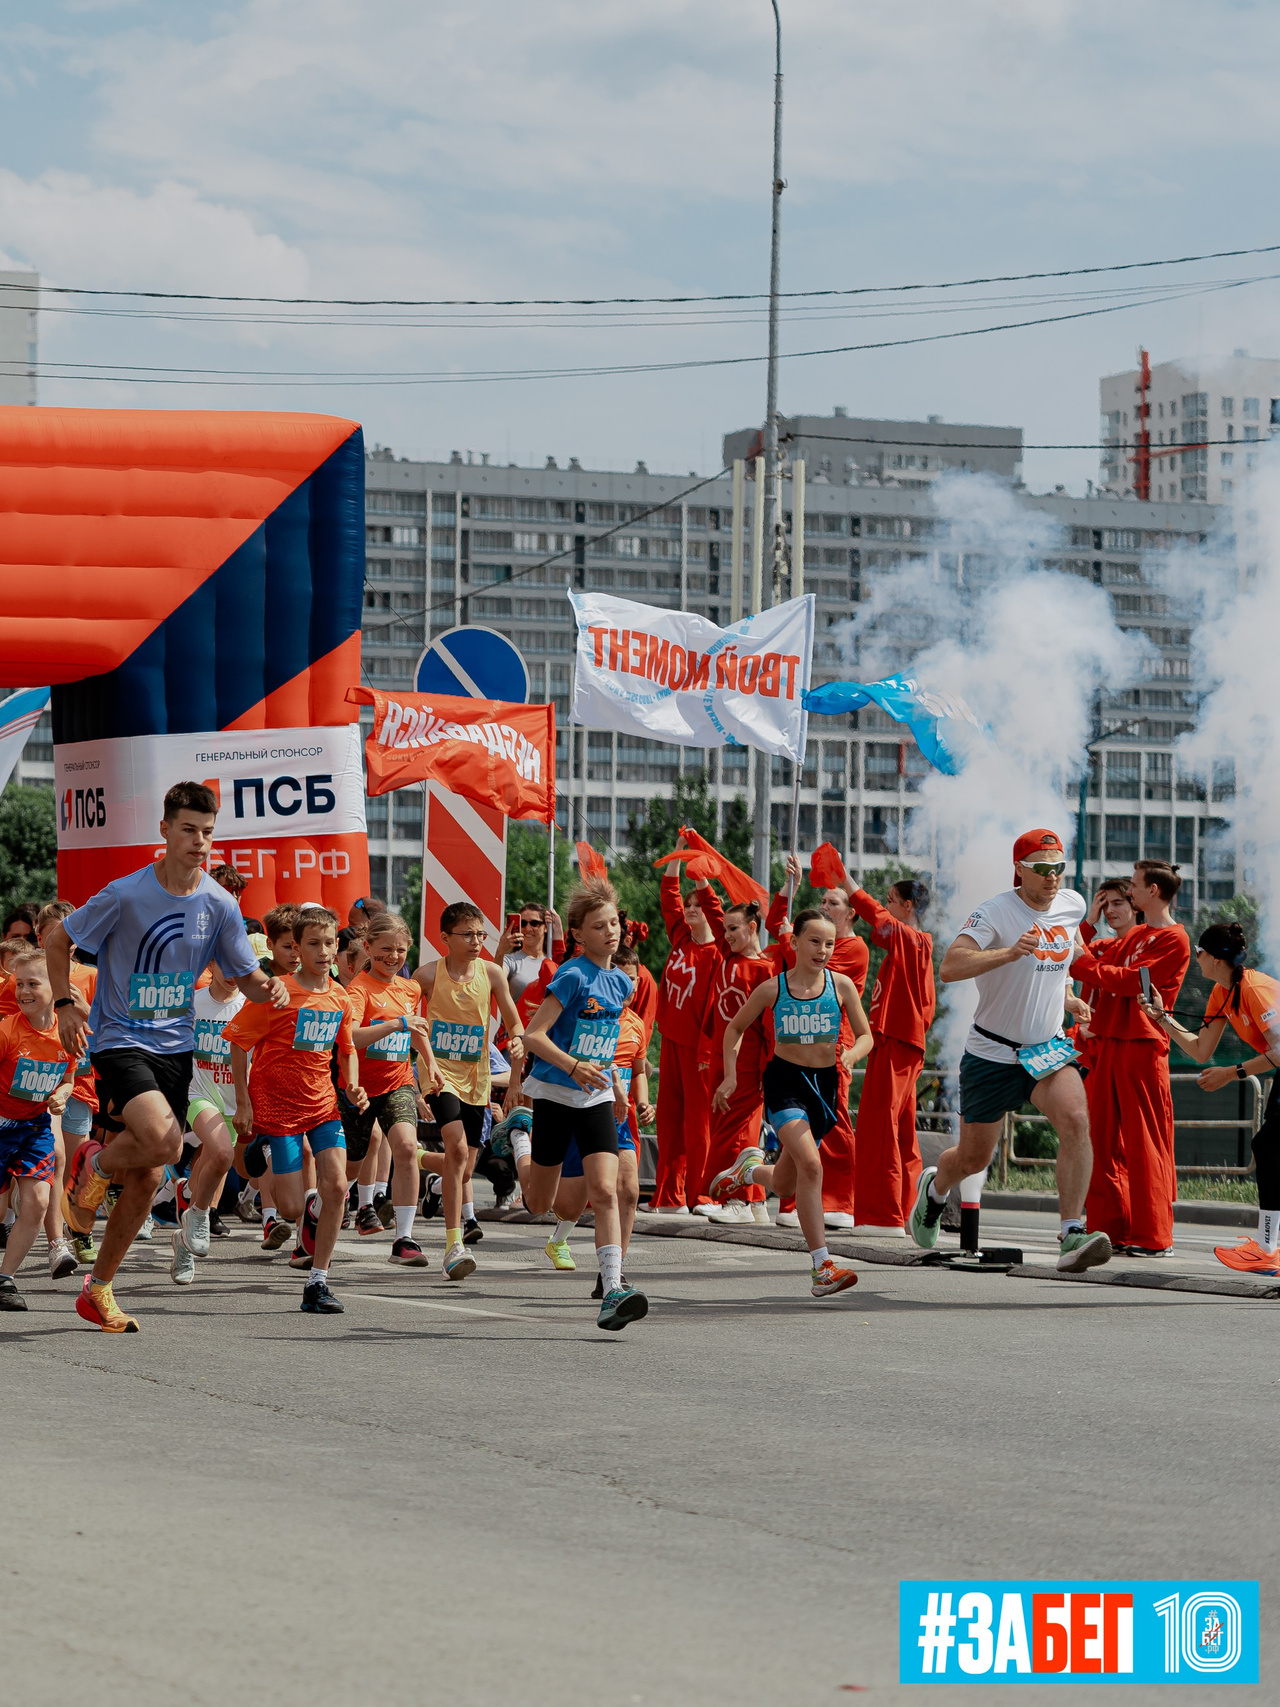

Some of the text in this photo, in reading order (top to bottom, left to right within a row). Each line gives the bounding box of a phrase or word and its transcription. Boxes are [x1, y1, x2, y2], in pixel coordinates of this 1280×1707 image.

[195, 747, 324, 762] ГЕНЕРАЛЬНЫЙ СПОНСОР
[233, 774, 336, 819] ПСБ
[75, 787, 106, 828] ПСБ
[154, 848, 350, 879] БЕГ.РФ
[1035, 964, 1065, 972] AMBSDR
[137, 985, 185, 1008] 10163
[154, 1009, 169, 1019] 1KM
[781, 1013, 831, 1034] 10065
[303, 1020, 337, 1042] 10219
[800, 1035, 815, 1044] 1KM
[198, 1032, 232, 1055] 1003
[314, 1043, 325, 1051] 1KM
[436, 1031, 479, 1053] 10379
[210, 1054, 223, 1063] 1KM
[386, 1052, 398, 1060] 1KM
[448, 1053, 461, 1062] 1KM
[1027, 1047, 1072, 1072] 10361
[19, 1069, 61, 1093] 10061
[32, 1092, 45, 1102] 1KM
